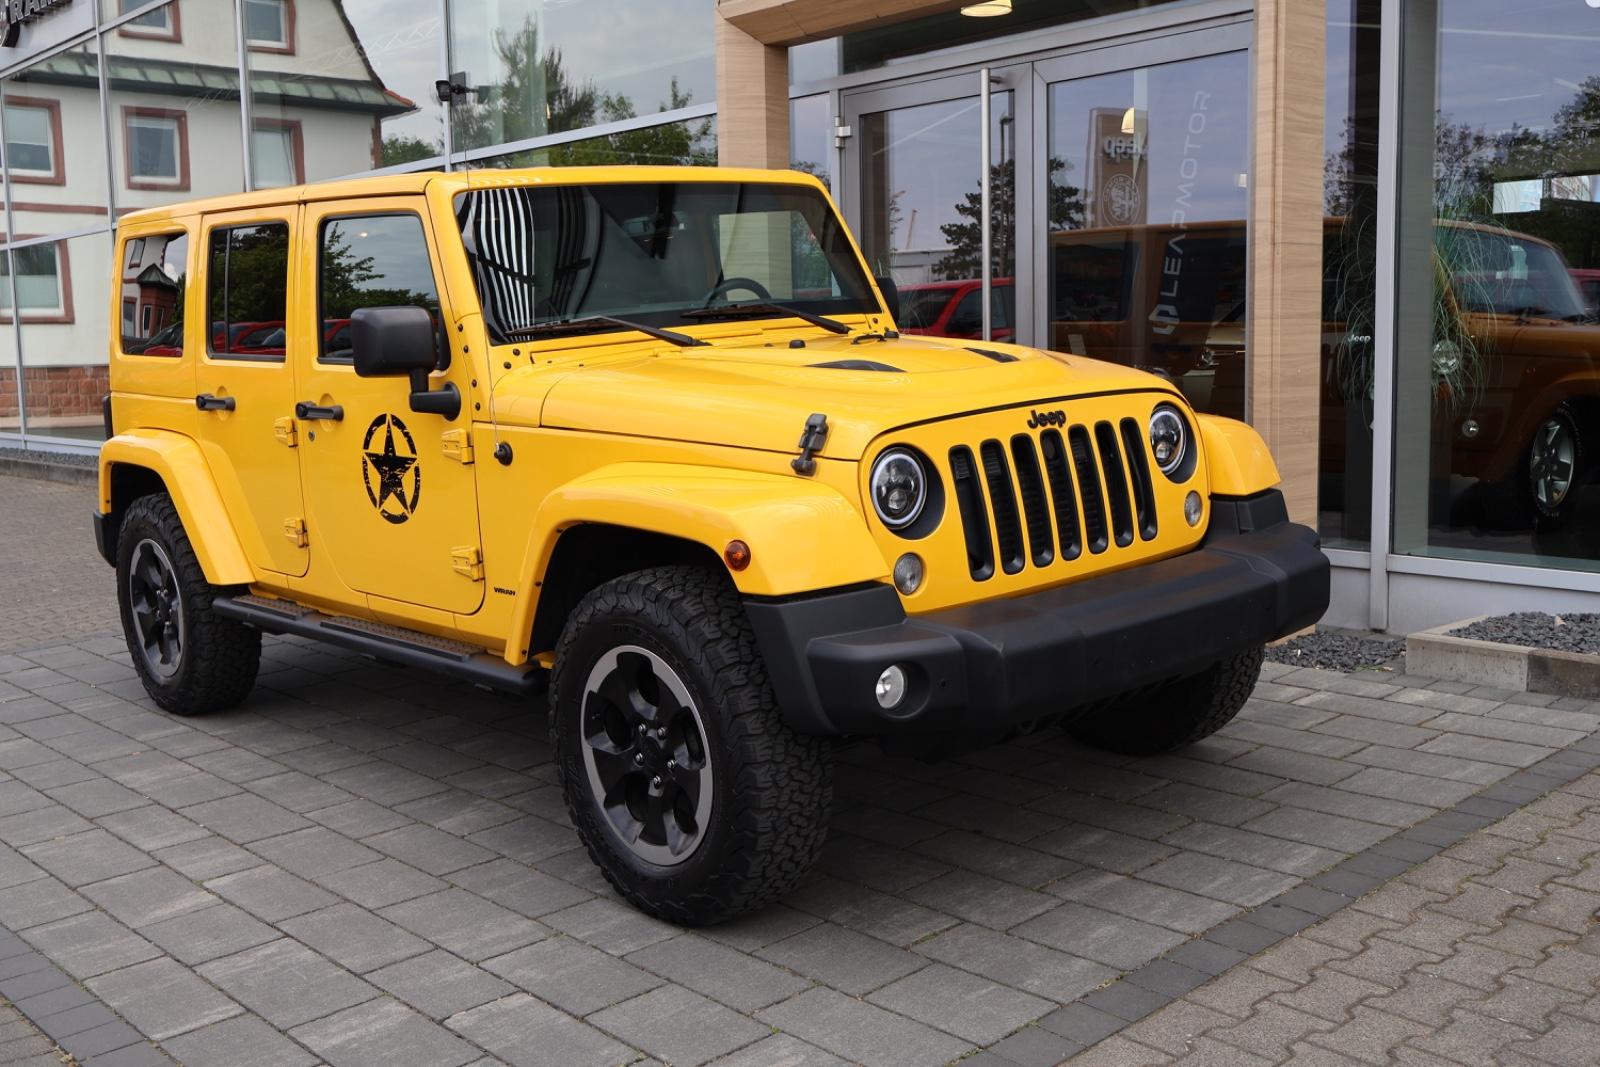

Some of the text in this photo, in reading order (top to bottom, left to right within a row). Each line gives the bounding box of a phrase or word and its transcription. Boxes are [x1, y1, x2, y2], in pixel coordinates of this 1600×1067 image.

[1160, 90, 1212, 298] LEAPMOTOR
[1347, 334, 1371, 343] Jeep
[1027, 409, 1066, 429] Jeep
